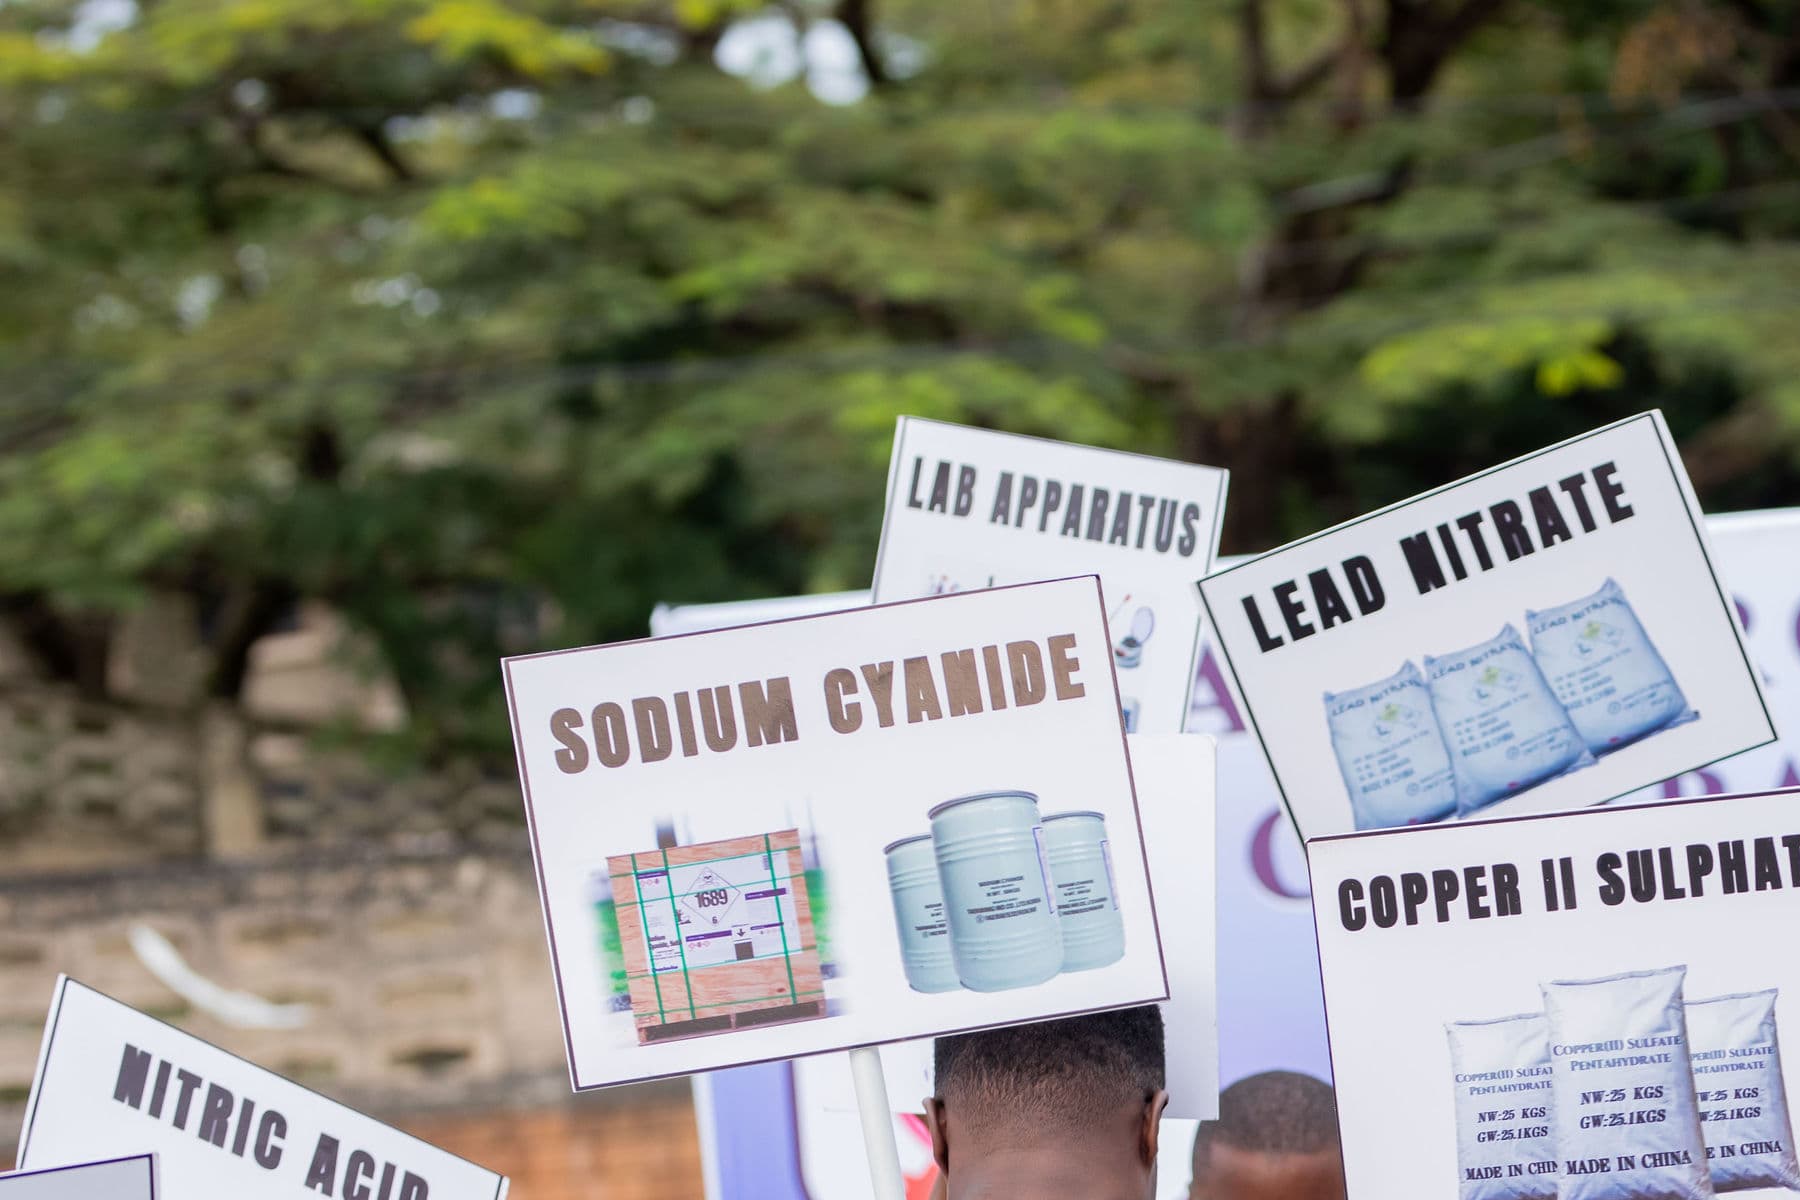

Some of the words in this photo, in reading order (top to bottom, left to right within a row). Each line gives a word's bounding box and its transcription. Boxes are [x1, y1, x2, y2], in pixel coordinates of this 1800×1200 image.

[907, 457, 976, 517] LAB
[990, 472, 1200, 557] APPARATUS
[1241, 554, 1386, 653] LEAD
[1399, 461, 1635, 595] NITRATE
[550, 676, 799, 774] SODIUM
[823, 633, 1085, 735] CYANIDE
[694, 888, 729, 908] 1689
[1338, 862, 1522, 932] COPPER
[1541, 857, 1577, 913] II
[1571, 1053, 1672, 1071] PENTAHYDRATE
[1580, 1088, 1626, 1106] NW:25
[1633, 1085, 1664, 1100] KGS
[1734, 1087, 1759, 1100] KGS
[113, 1043, 287, 1171] NITRIC
[1477, 1109, 1515, 1123] NW:25
[1521, 1107, 1546, 1119] KGS
[1720, 1144, 1736, 1158] IN
[1740, 1140, 1782, 1156] CHINA
[1465, 1166, 1502, 1181] MADE
[1508, 1164, 1523, 1177] IN
[1566, 1157, 1611, 1175] MADE
[1617, 1155, 1636, 1171] IN
[1641, 1150, 1692, 1168] CHINA
